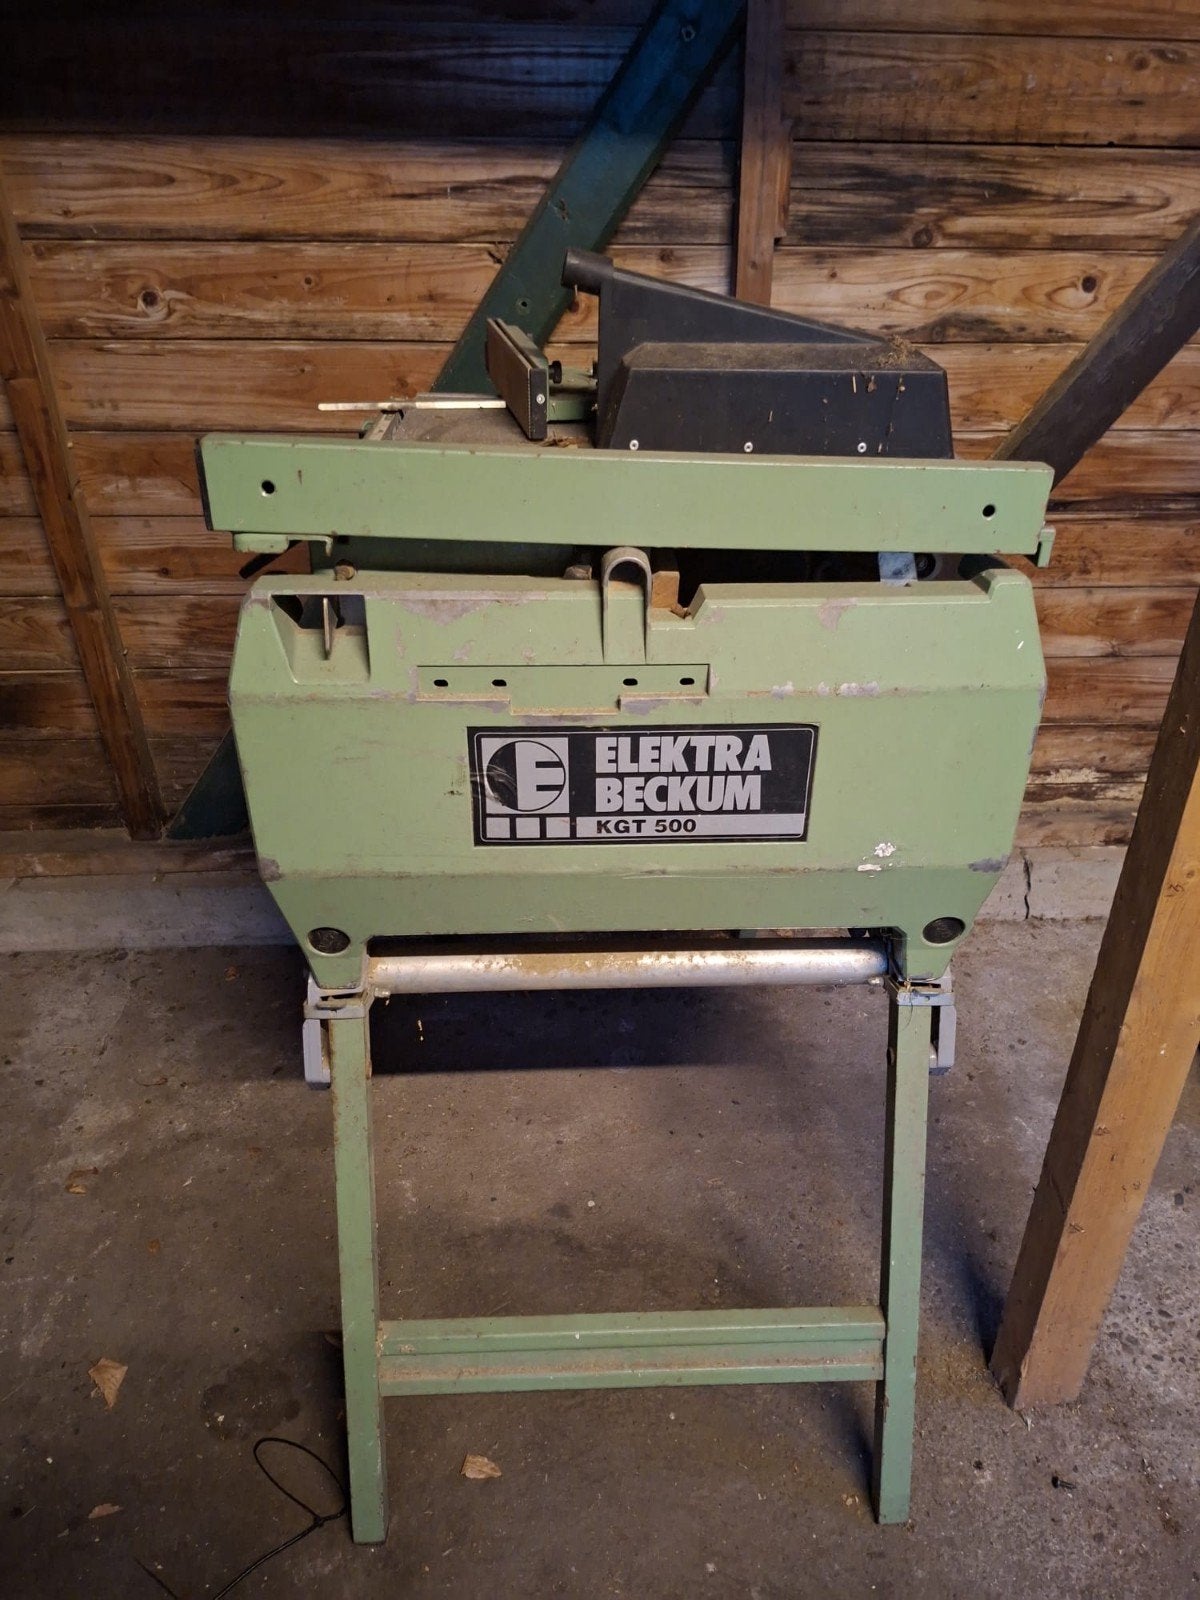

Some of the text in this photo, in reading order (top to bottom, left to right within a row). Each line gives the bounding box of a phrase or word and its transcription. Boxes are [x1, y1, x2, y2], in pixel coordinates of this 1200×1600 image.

[595, 735, 772, 773] ELEKTRA
[595, 775, 761, 813] BECKUM
[596, 819, 697, 834] KGT 500
